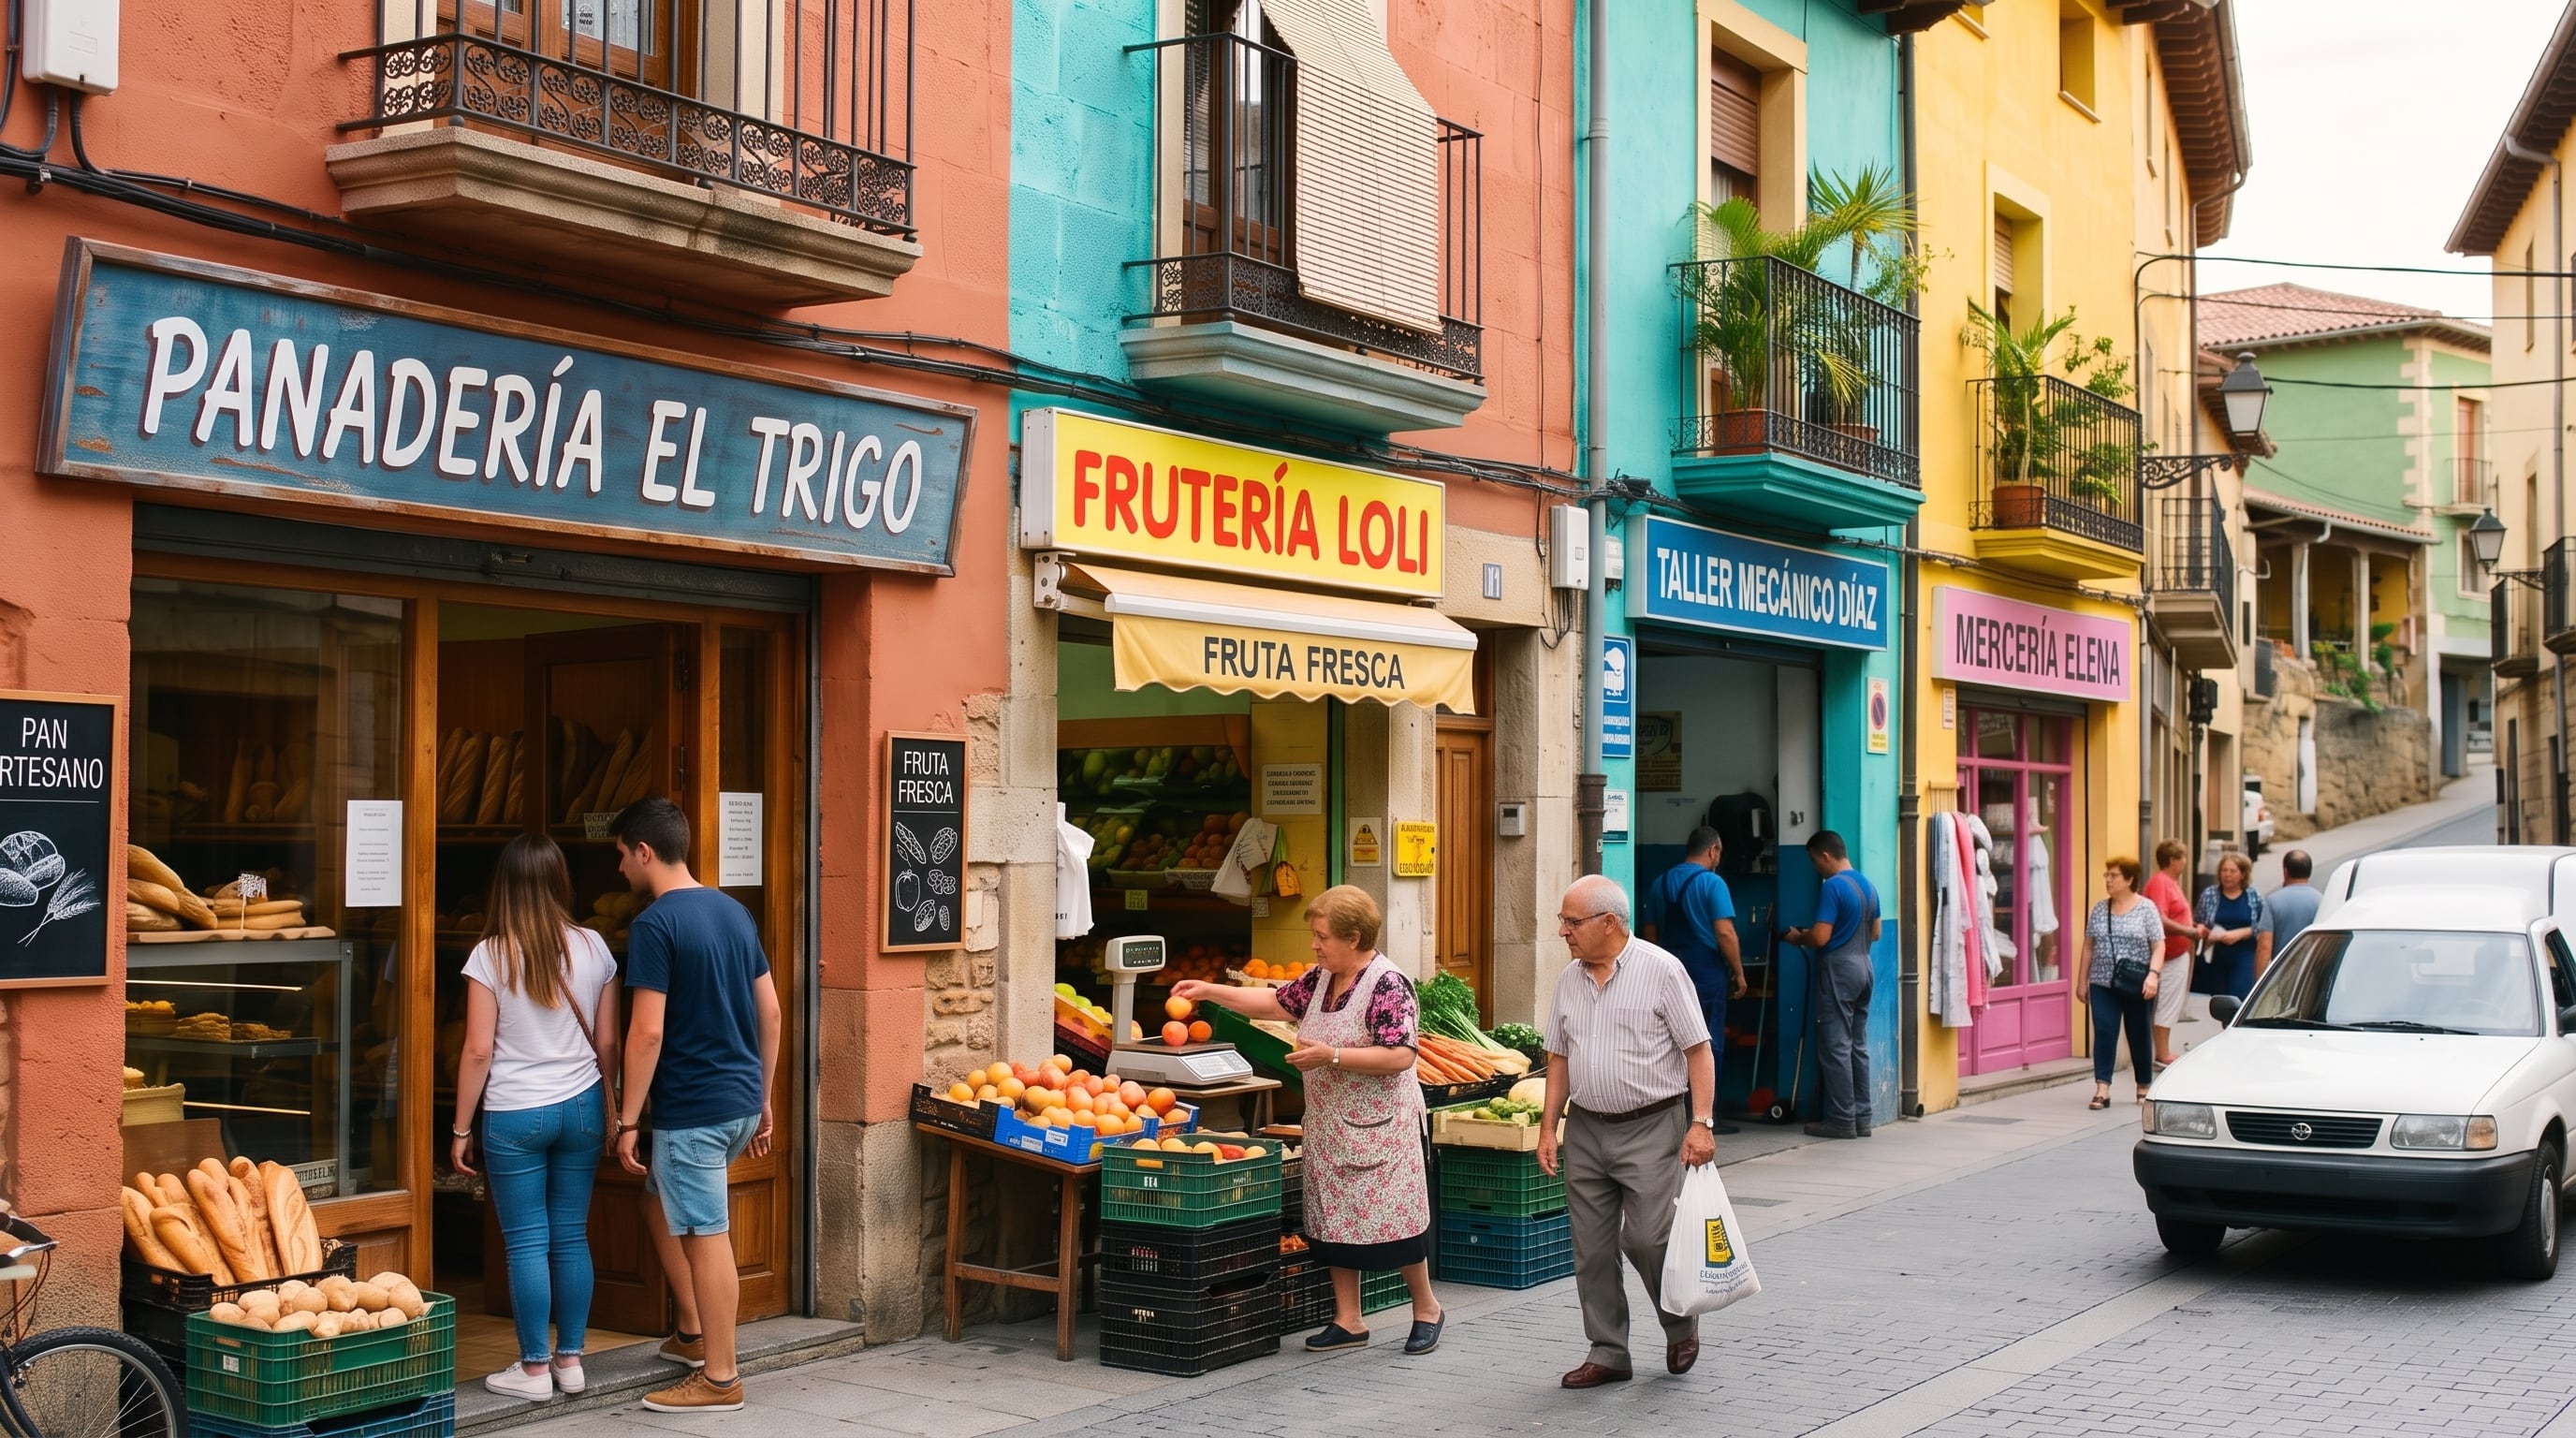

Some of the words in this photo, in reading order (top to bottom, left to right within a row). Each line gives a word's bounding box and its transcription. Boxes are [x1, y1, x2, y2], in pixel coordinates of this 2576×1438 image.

[144, 315, 604, 493] PANADERÍA
[641, 400, 716, 508] EL
[750, 417, 923, 535] TRIGO
[1074, 449, 1320, 561] FRUTERÍA
[1339, 495, 1428, 576] LOLI
[1657, 547, 1733, 608] TALLER
[1738, 559, 1835, 624] MECÁNICO
[1838, 572, 1878, 631] DÍAZ
[1203, 636, 1295, 681] FRUTA
[1307, 646, 1405, 689] FRESCA
[1956, 614, 2058, 678] MERCERÍA
[2065, 633, 2121, 685] ELENA
[22, 717, 67, 749] PAN
[0, 756, 103, 789] RTESANO
[904, 751, 949, 775] FRUTA
[899, 780, 954, 804] FRESCA
